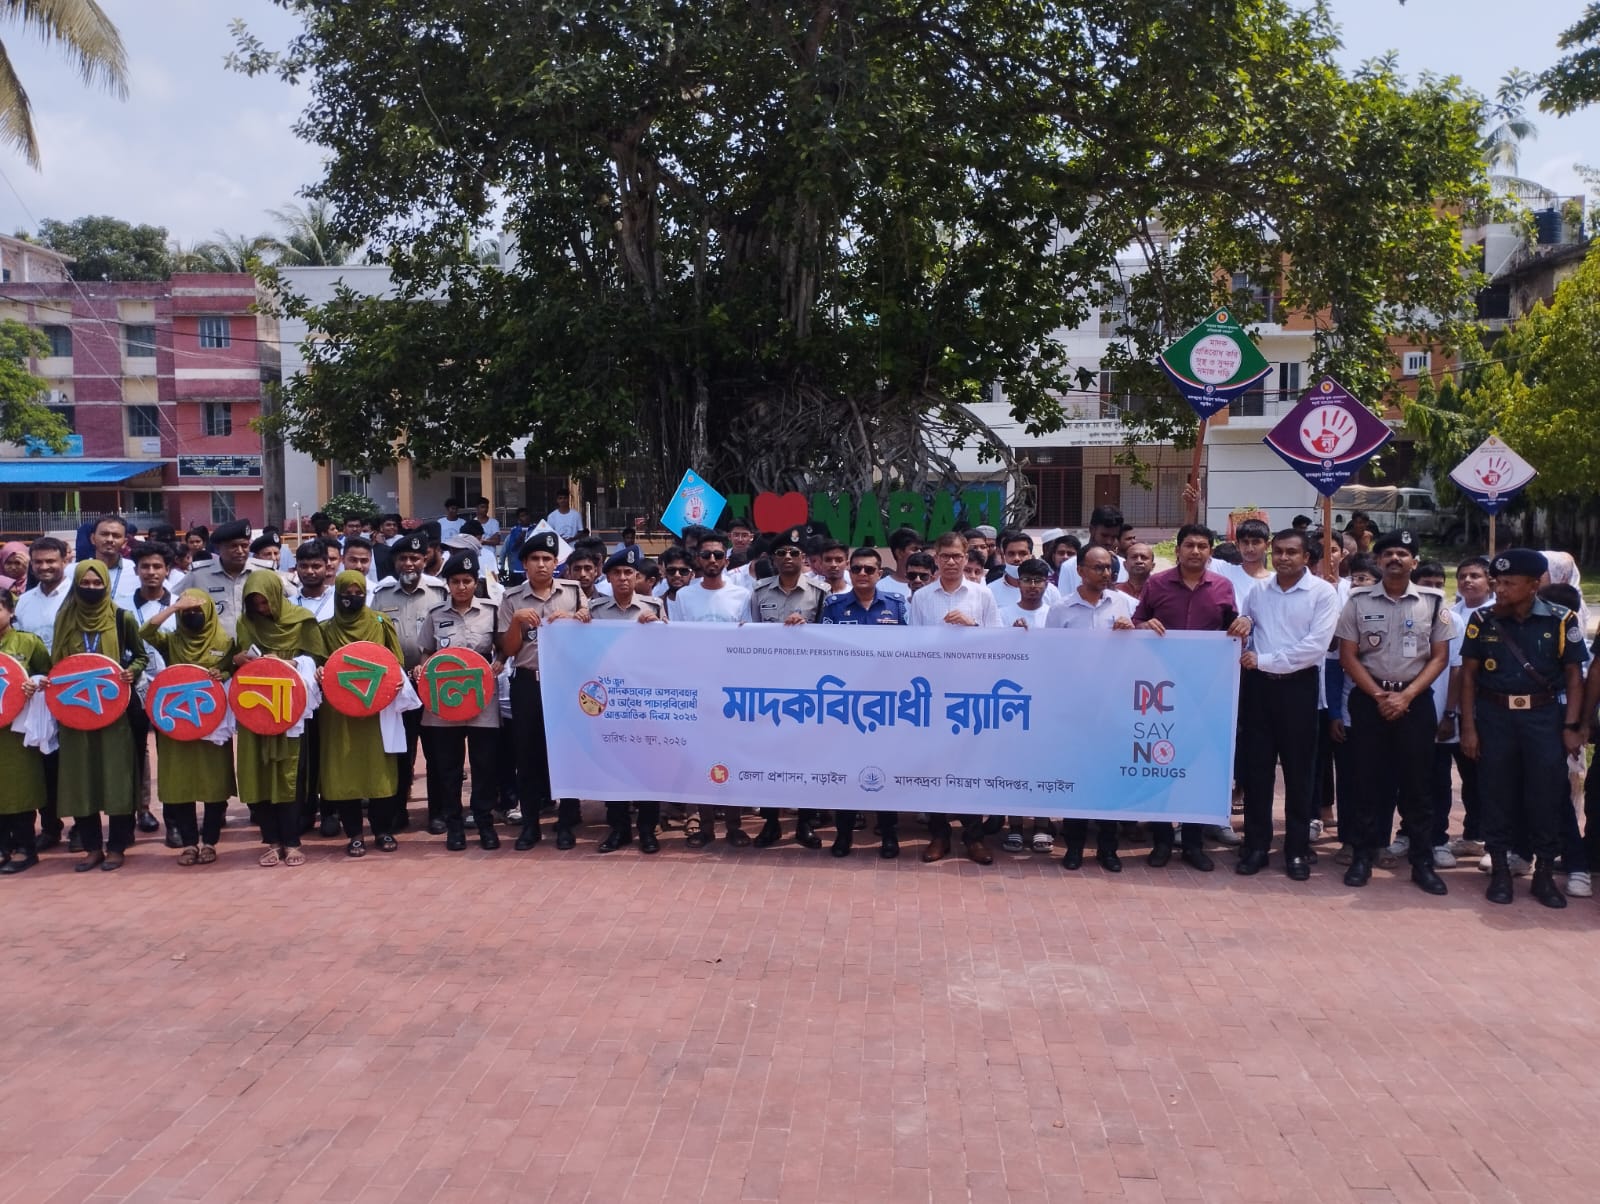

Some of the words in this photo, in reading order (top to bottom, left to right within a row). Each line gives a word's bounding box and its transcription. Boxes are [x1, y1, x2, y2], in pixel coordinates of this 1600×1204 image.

[753, 647, 773, 655] DRUG
[809, 648, 849, 657] PERSISTING
[943, 652, 988, 660] INNOVATIVE
[988, 653, 1030, 661] RESPONSES
[337, 654, 388, 709] ব
[424, 654, 486, 716] লি
[237, 675, 297, 723] না
[722, 674, 933, 734] মাদকবিরোধী
[1133, 722, 1175, 739] SAY
[630, 734, 642, 743] ২৬
[663, 736, 687, 746] ২০২৬
[738, 770, 765, 782] জেলা
[767, 770, 807, 785] প্রশাসন,
[811, 771, 848, 785] নড়াইল
[1120, 766, 1138, 777] TO
[1142, 767, 1187, 778] DRUGS
[893, 775, 942, 789] মাদকদ্রব্য
[1037, 779, 1076, 793] নড়াইল
